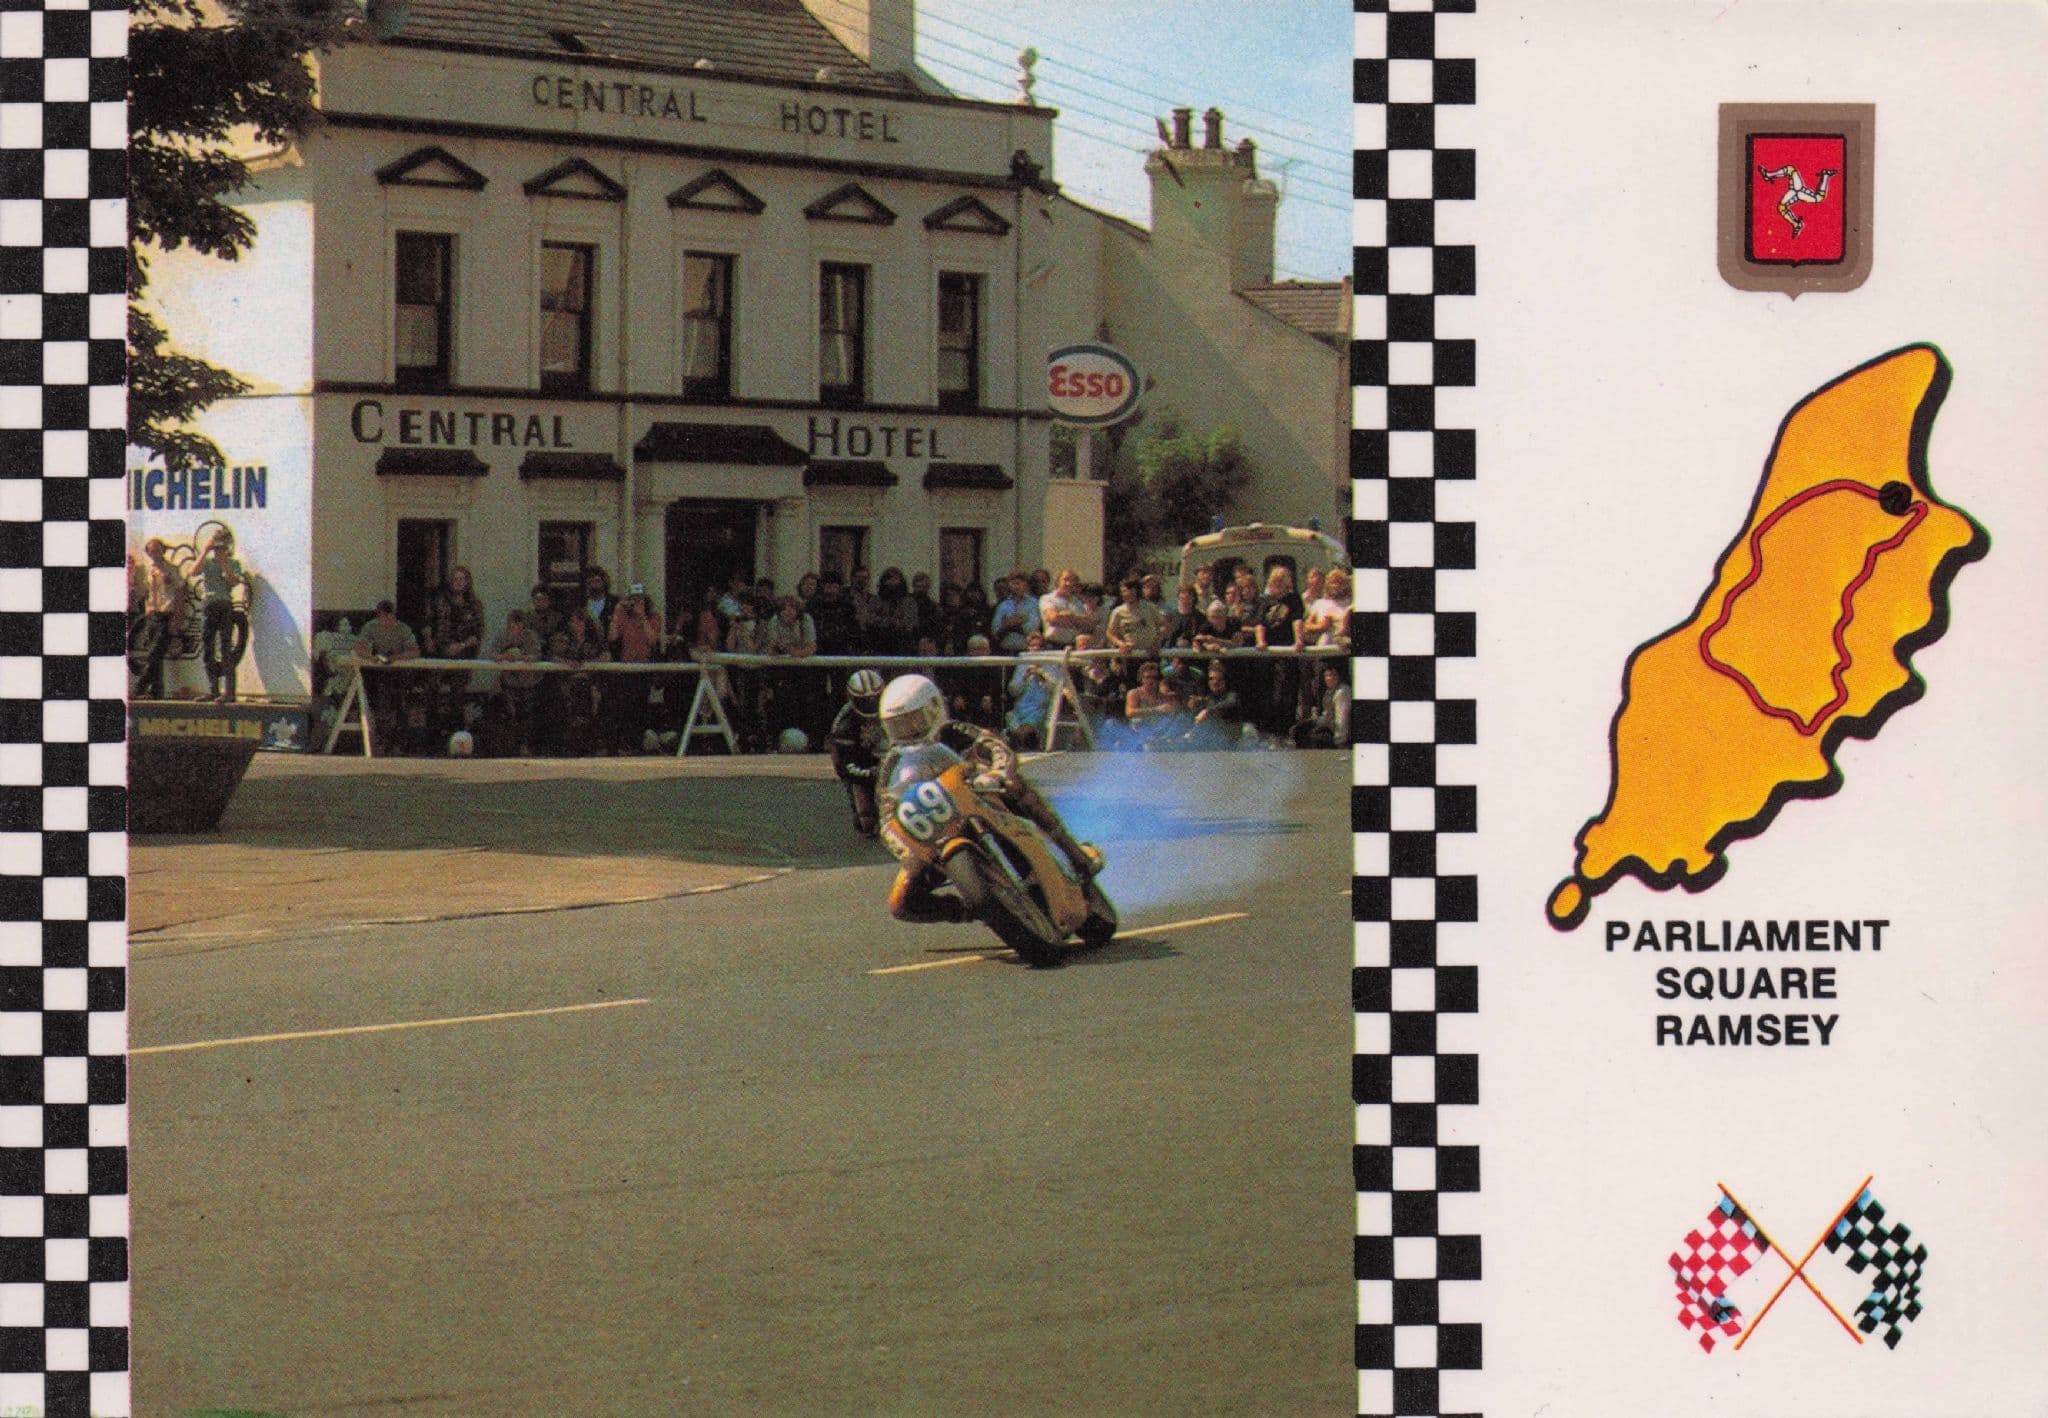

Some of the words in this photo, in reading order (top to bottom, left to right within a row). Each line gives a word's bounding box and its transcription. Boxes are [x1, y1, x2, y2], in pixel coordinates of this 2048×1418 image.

[531, 74, 707, 122] CENTRAL
[780, 102, 901, 143] HOTEL
[351, 400, 573, 448] CENTRAL
[808, 415, 947, 459] HOTEL
[128, 467, 267, 510] ICHELIN
[138, 717, 263, 740] MICHELIN
[897, 782, 952, 841] 69
